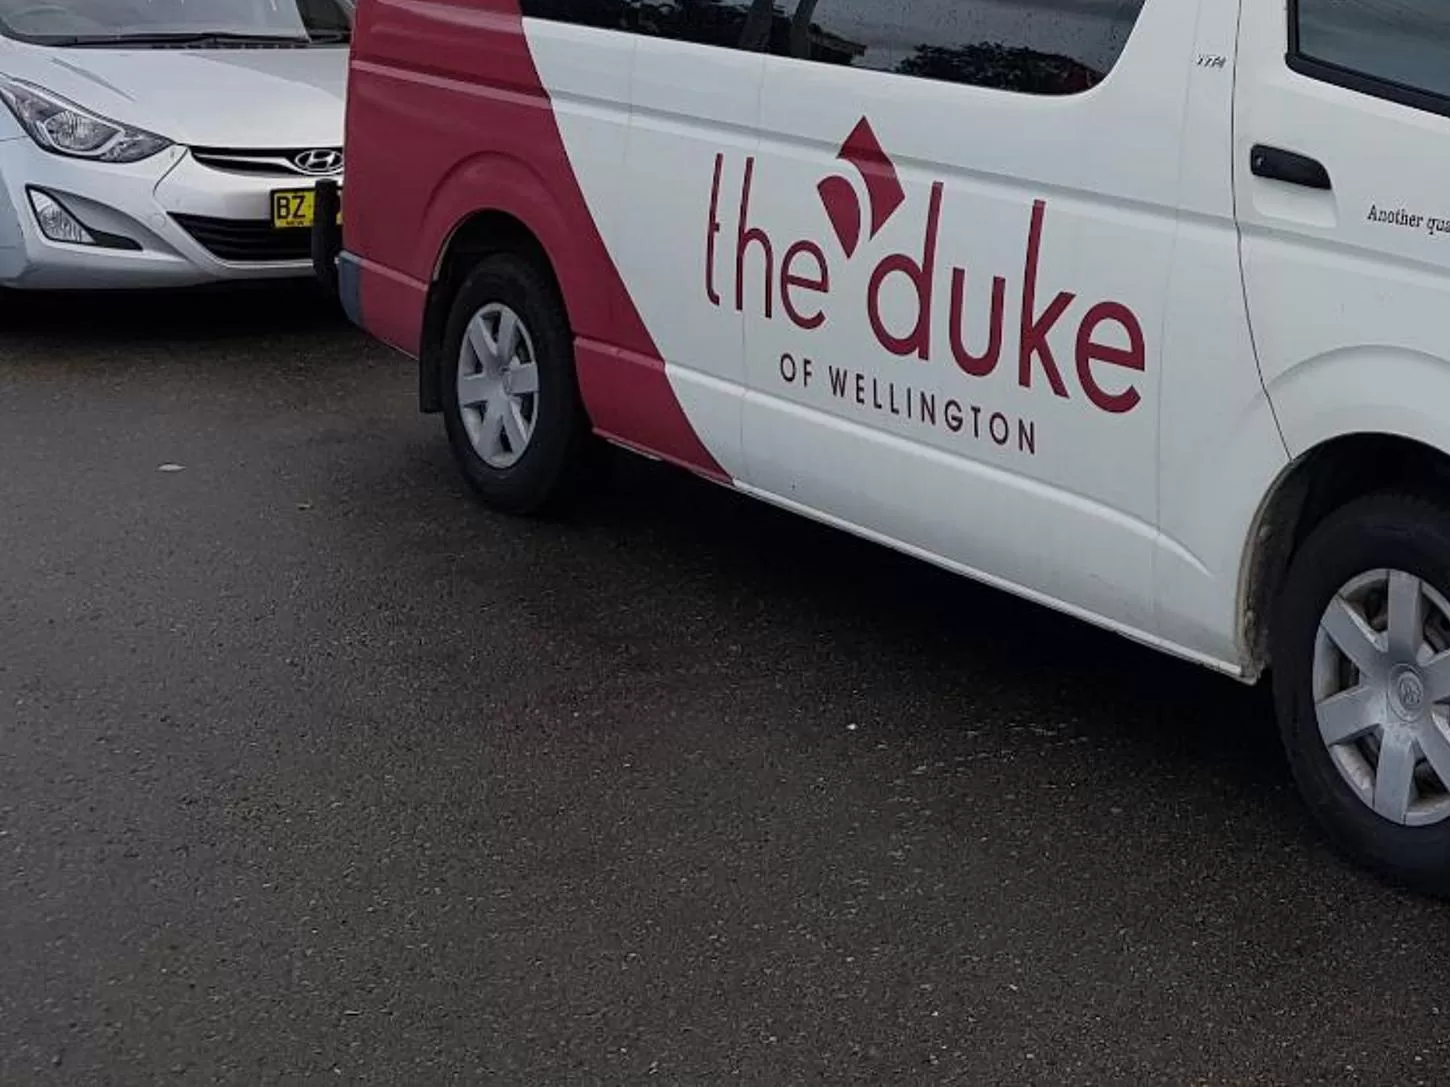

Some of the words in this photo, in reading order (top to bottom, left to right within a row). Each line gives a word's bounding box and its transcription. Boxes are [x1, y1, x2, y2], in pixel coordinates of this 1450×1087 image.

[276, 195, 307, 220] BZ
[1367, 203, 1424, 228] Another
[704, 151, 831, 331] the
[865, 180, 1147, 415] duke
[778, 352, 815, 388] OF
[828, 364, 1038, 456] WELLINGTON
